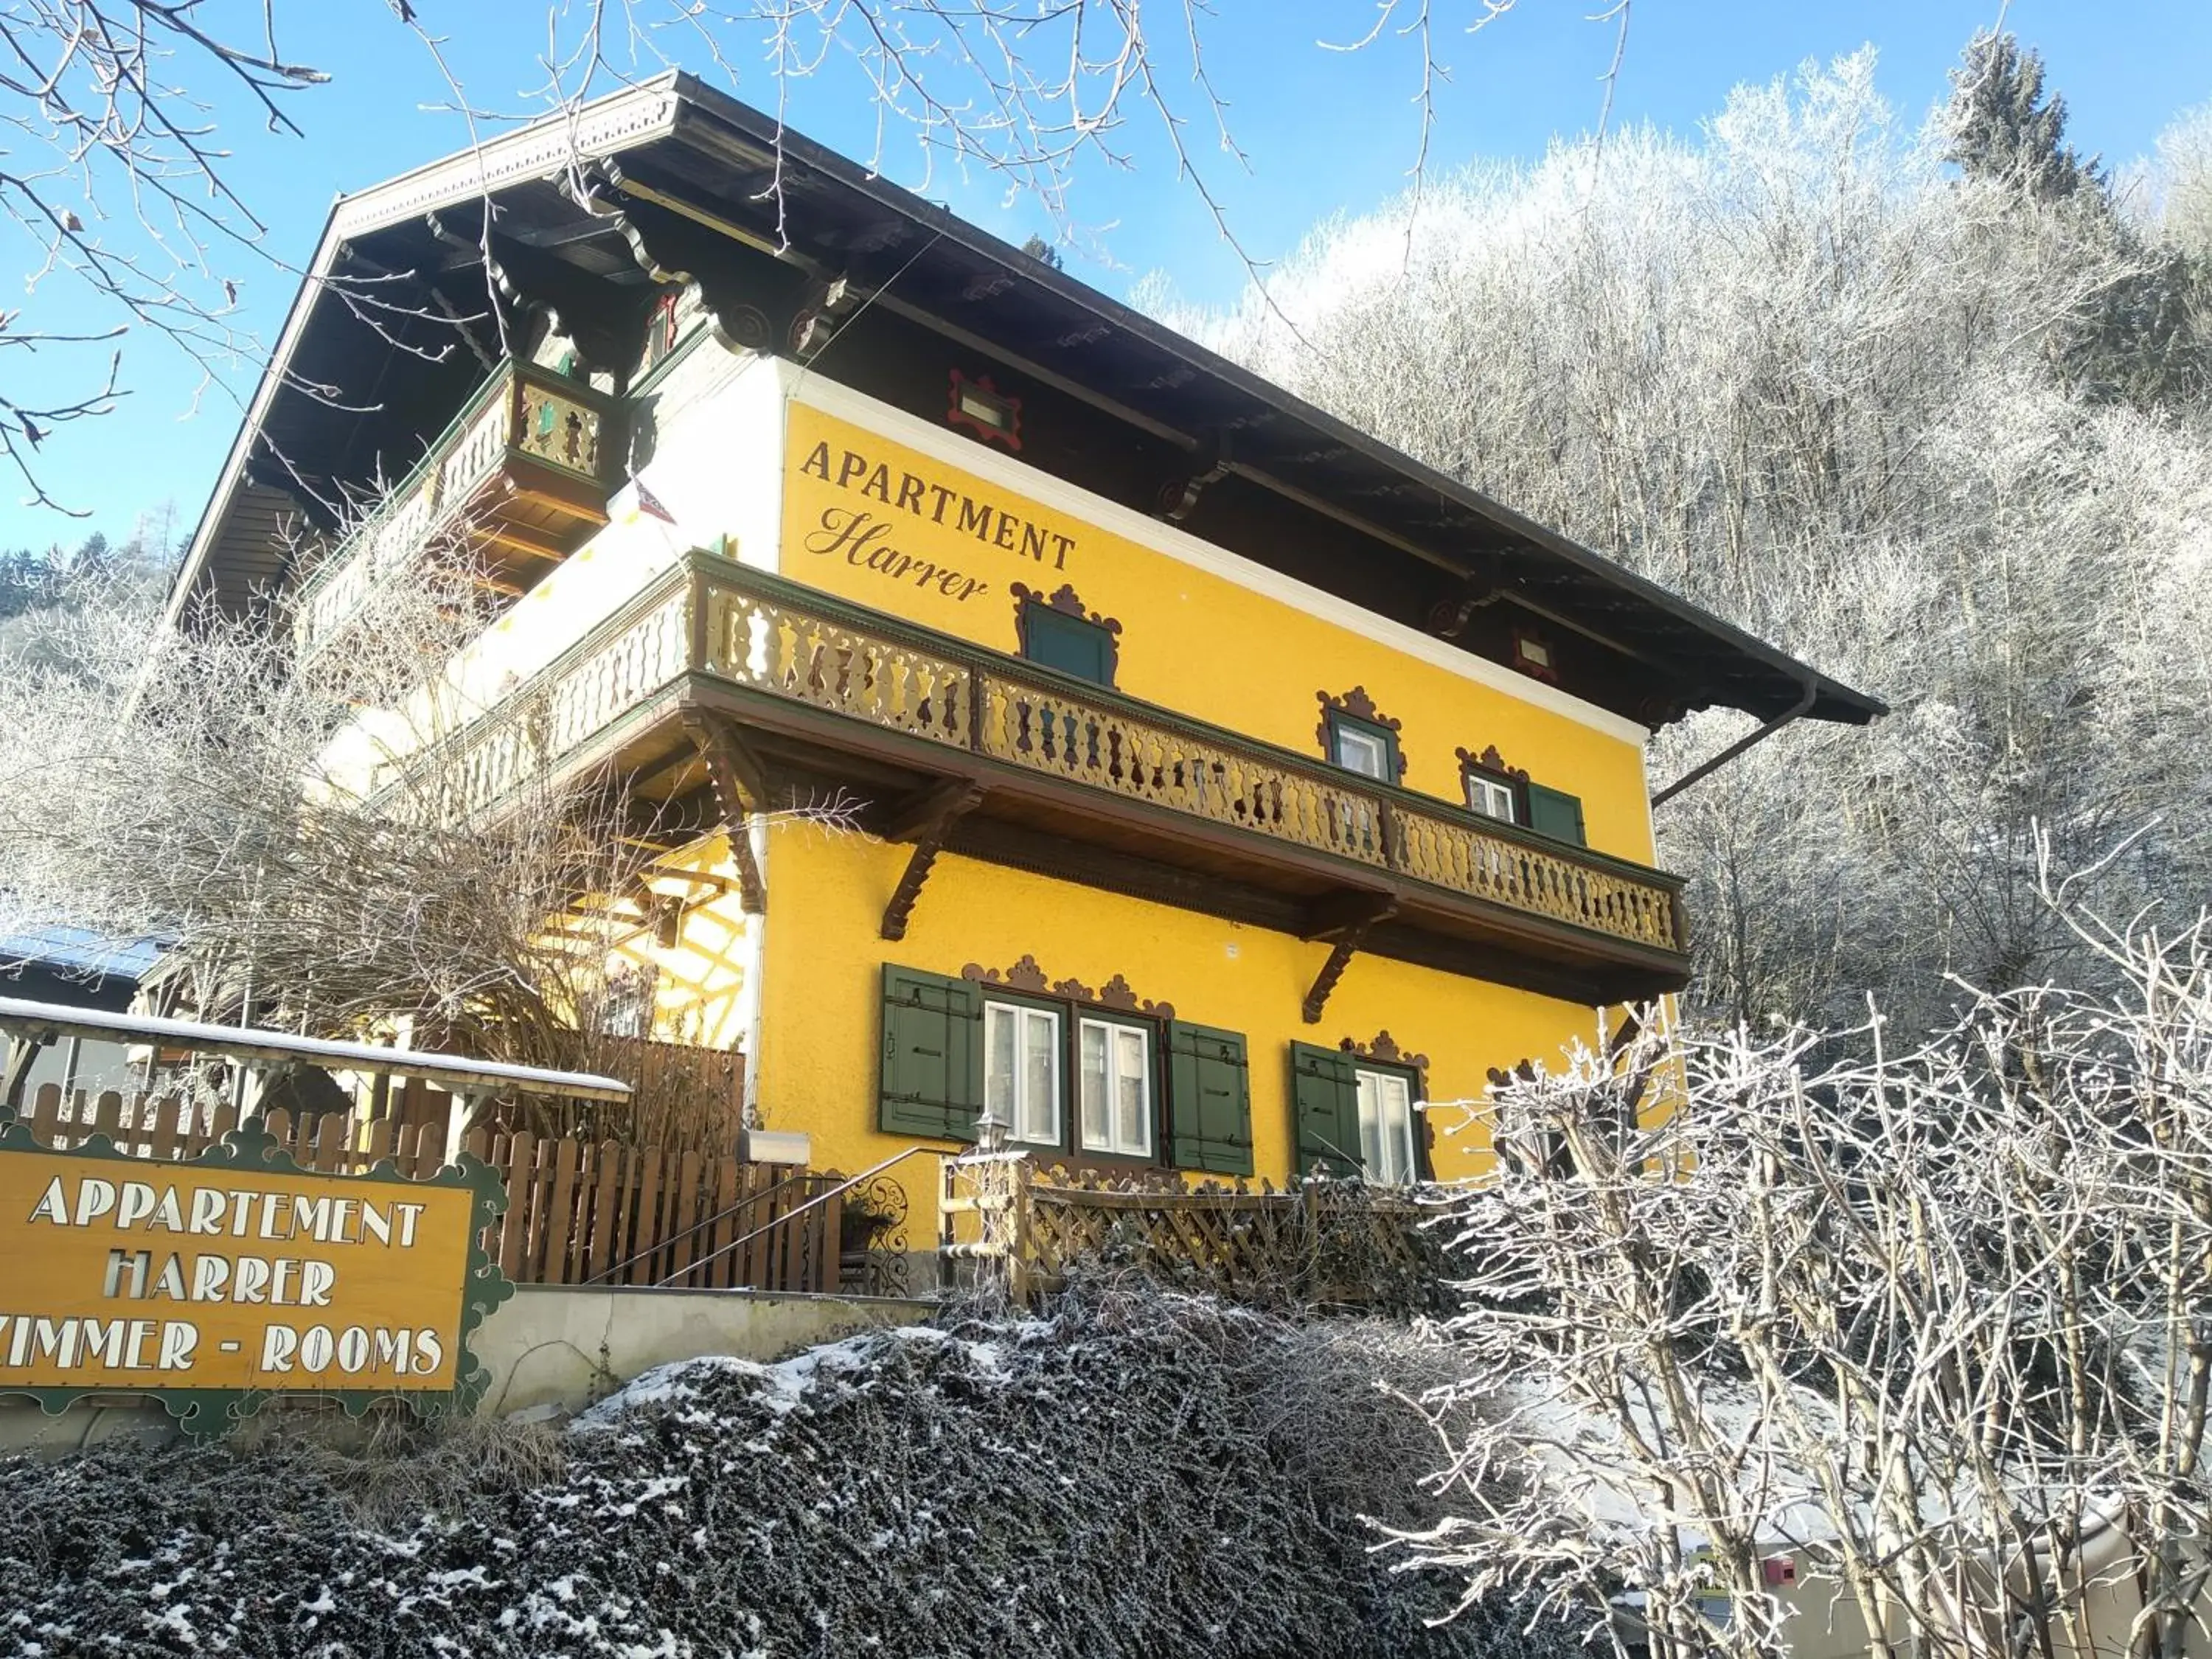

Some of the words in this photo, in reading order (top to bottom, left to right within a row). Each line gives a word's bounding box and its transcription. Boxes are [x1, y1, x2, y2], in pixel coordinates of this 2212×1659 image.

[800, 440, 1076, 571] APARTMENT
[804, 507, 989, 602] Harrer
[27, 1176, 425, 1248] APPARTEMENT
[102, 1248, 335, 1307] HARRER
[260, 1324, 442, 1376] ROOMS
